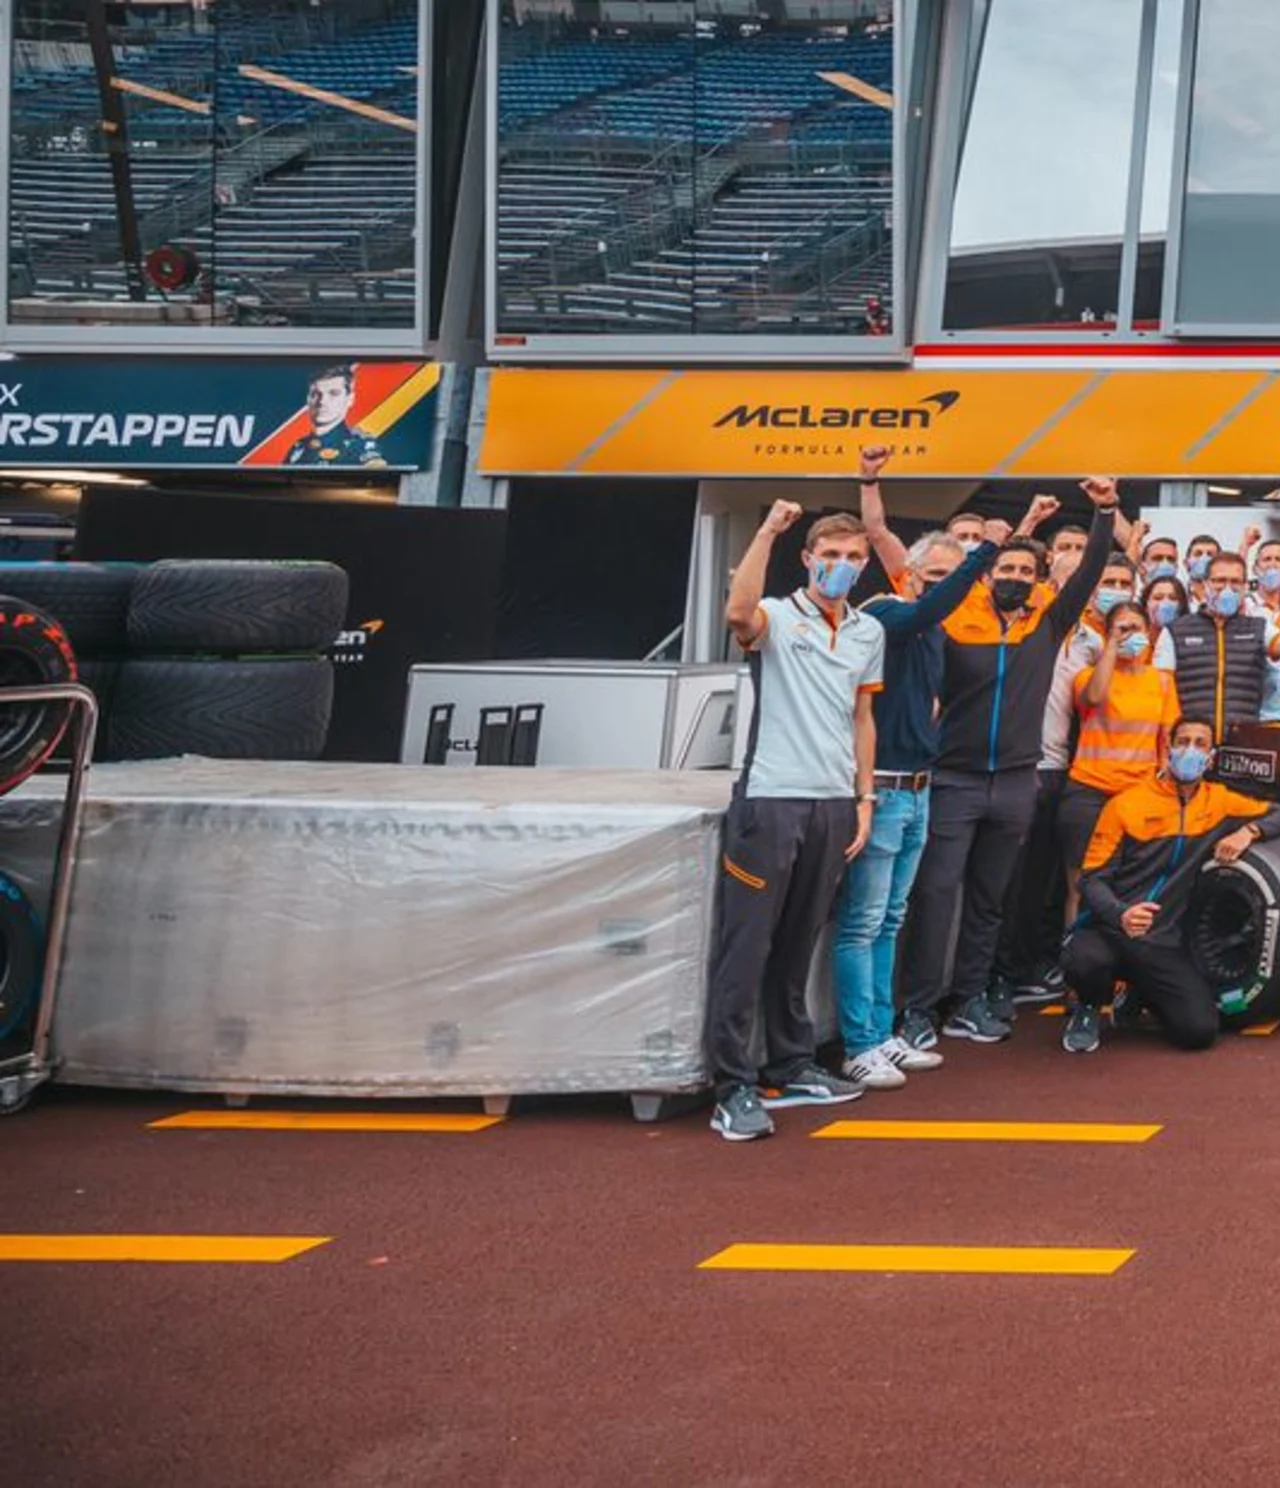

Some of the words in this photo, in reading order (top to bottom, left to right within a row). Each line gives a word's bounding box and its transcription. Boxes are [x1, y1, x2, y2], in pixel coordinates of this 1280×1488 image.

[712, 405, 931, 428] McLaren
[754, 445, 845, 455] FORMULA
[1224, 754, 1271, 777] Hilton
